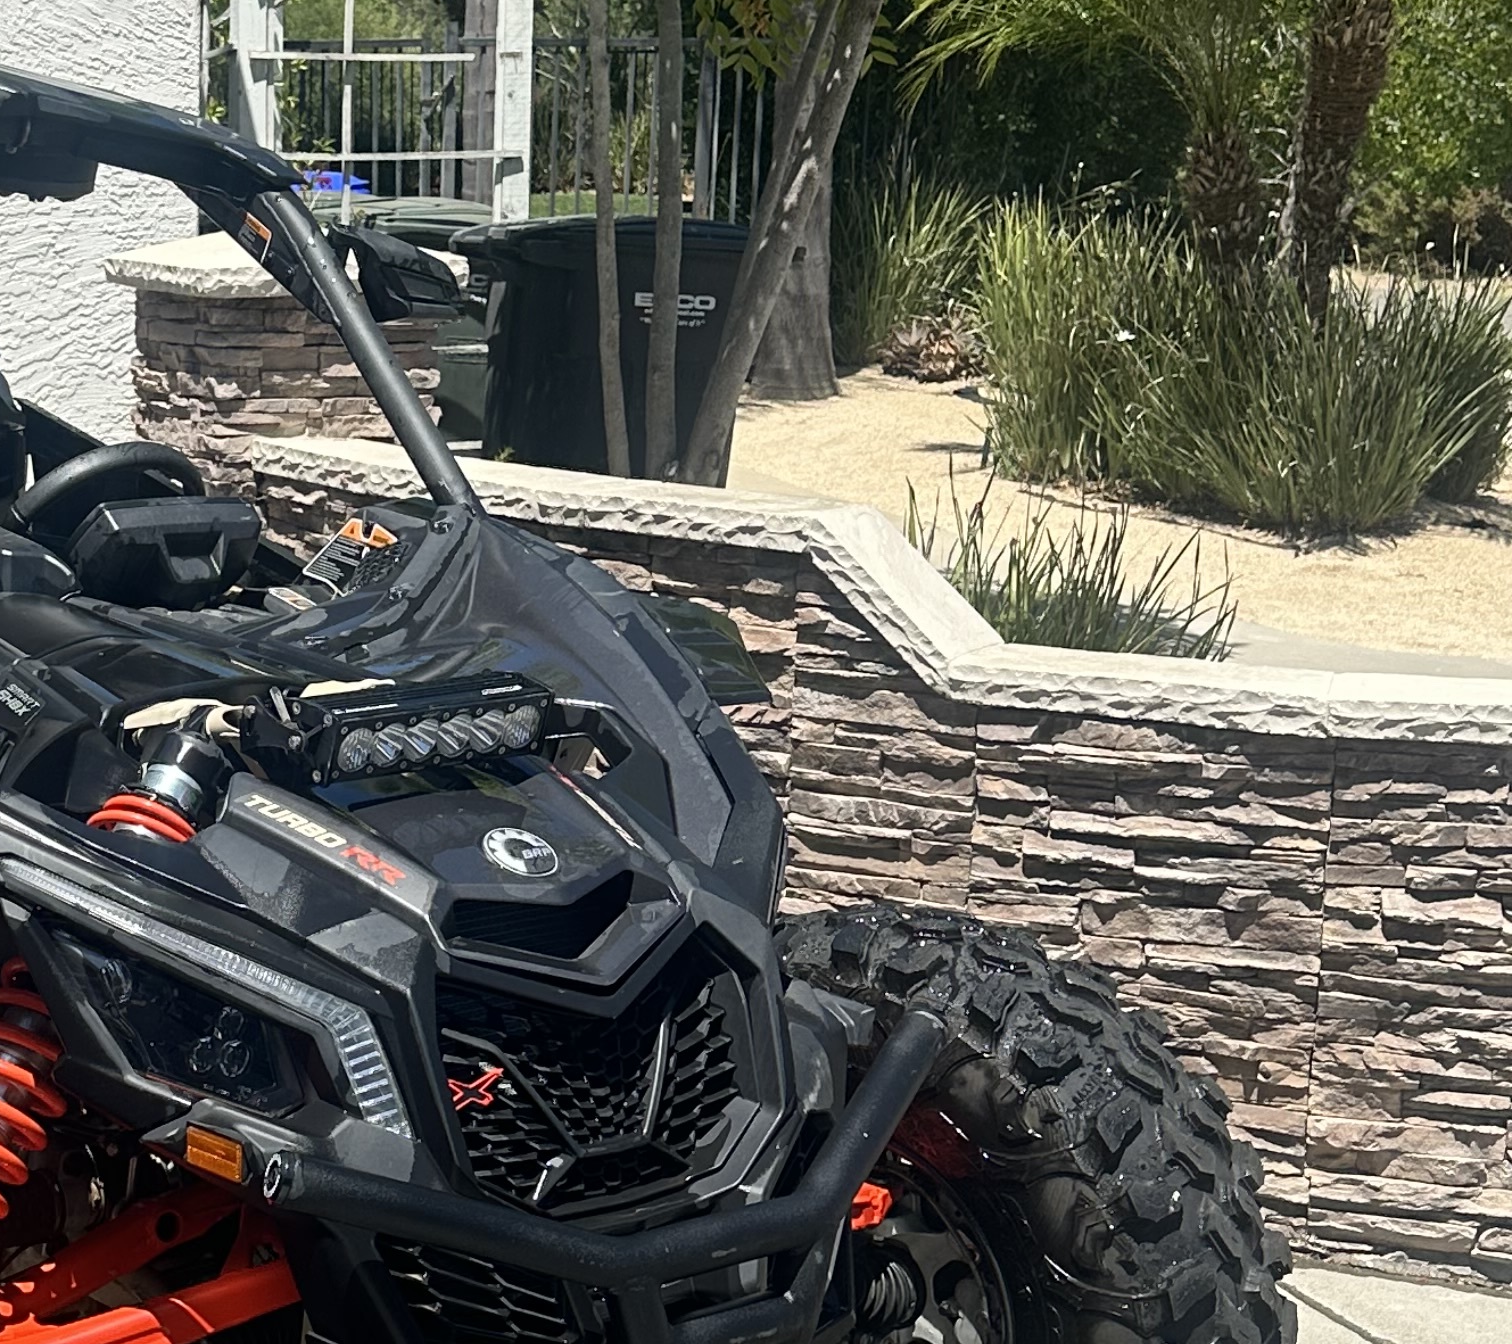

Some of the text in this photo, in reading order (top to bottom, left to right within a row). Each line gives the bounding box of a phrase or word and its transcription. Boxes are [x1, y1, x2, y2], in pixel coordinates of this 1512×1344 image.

[634, 291, 716, 311] ECO
[6, 683, 40, 708] SMART
[244, 794, 406, 886] TURBO RR
[522, 847, 552, 859] BRP
